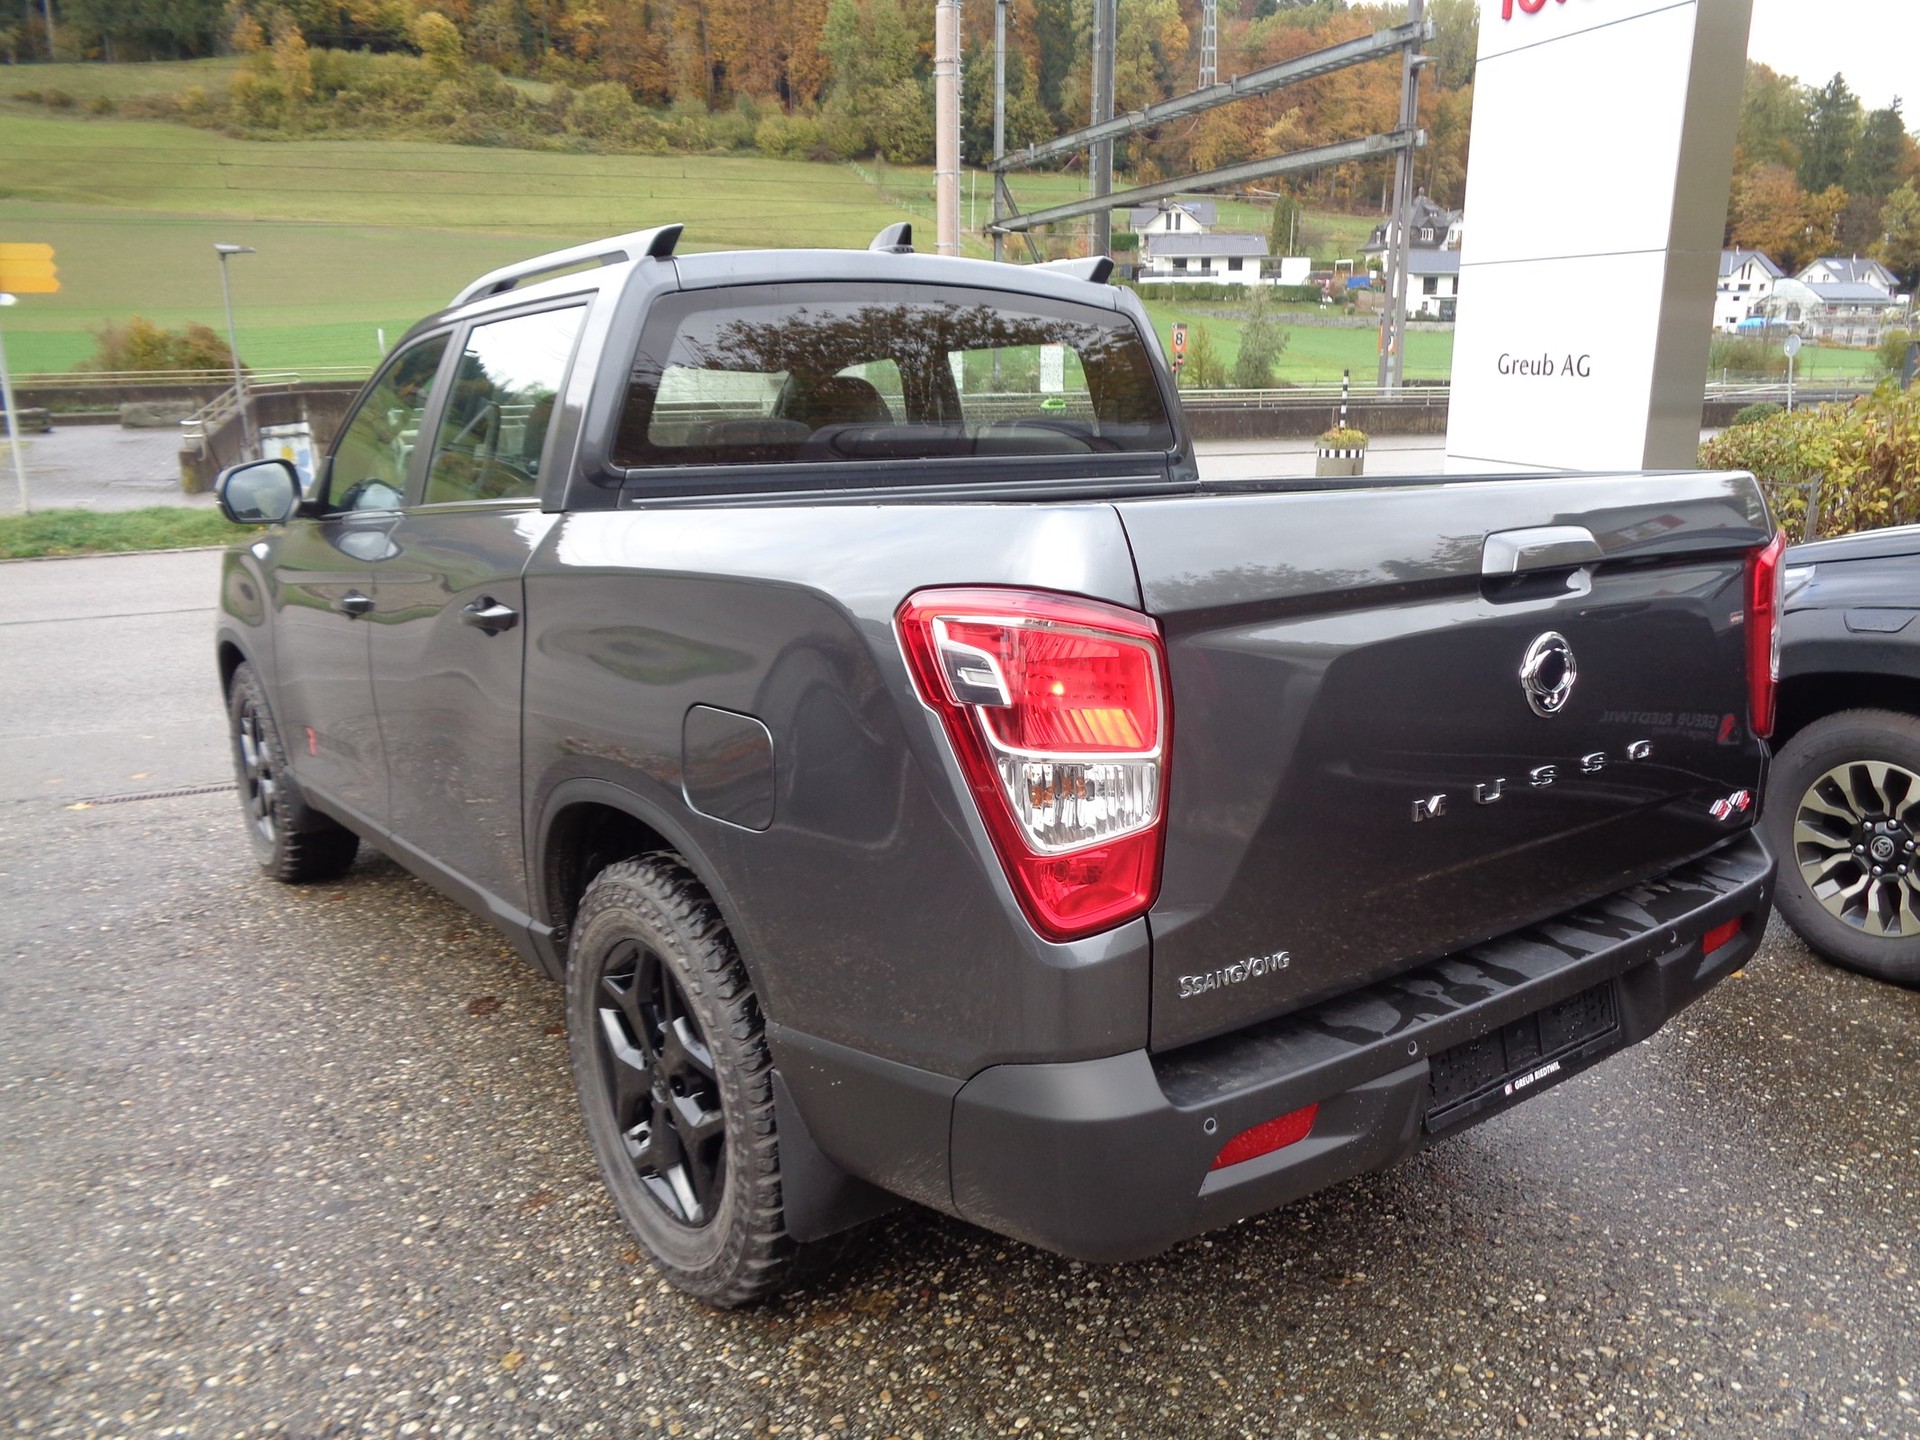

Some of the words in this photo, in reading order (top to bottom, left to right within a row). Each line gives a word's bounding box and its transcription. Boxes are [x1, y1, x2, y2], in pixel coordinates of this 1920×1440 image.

[1175, 331, 1183, 346] 8
[1498, 352, 1554, 376] Greub
[1560, 353, 1591, 378] AG
[1412, 739, 1652, 822] MUSSO
[1514, 1073, 1535, 1090] GREUB
[1534, 1061, 1561, 1081] RIEDTWIL
